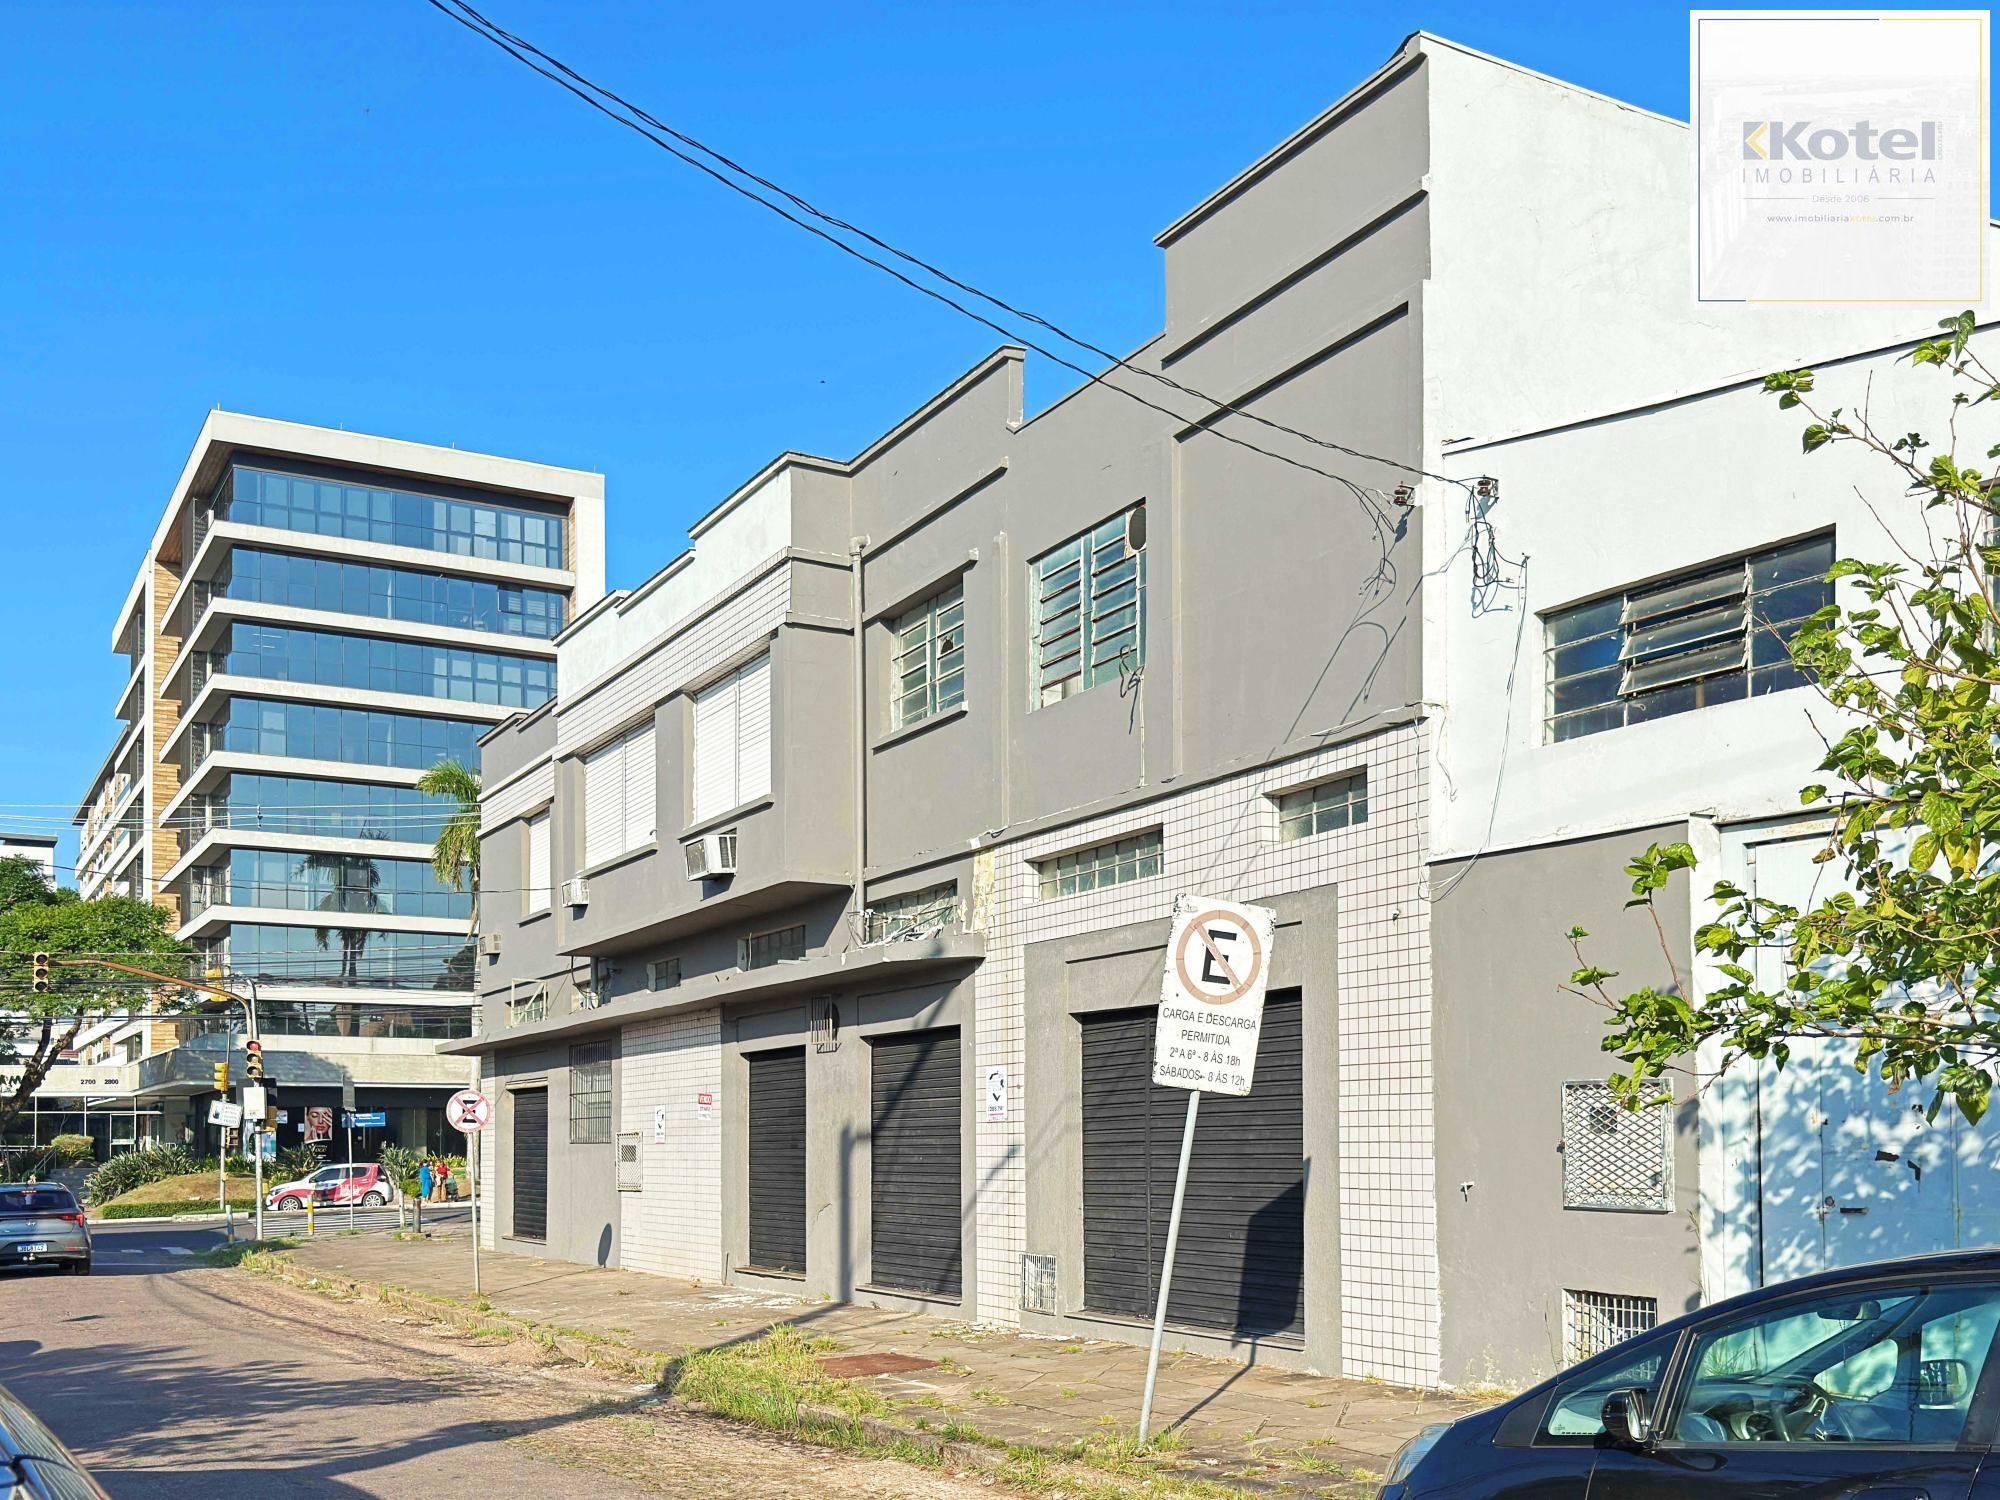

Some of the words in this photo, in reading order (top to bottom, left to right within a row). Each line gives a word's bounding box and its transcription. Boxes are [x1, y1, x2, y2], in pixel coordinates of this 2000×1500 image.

[1163, 1007, 1195, 1022] CARGA
[1198, 1012, 1204, 1023] E
[1206, 1012, 1256, 1030] DESCARGA
[1181, 1029, 1230, 1046] PERMITIDA
[1179, 1048, 1186, 1059] A
[1203, 1051, 1209, 1062] 8
[1226, 1055, 1241, 1067] 18h
[1207, 1071, 1214, 1082] 8
[1231, 1074, 1246, 1086] 12h
